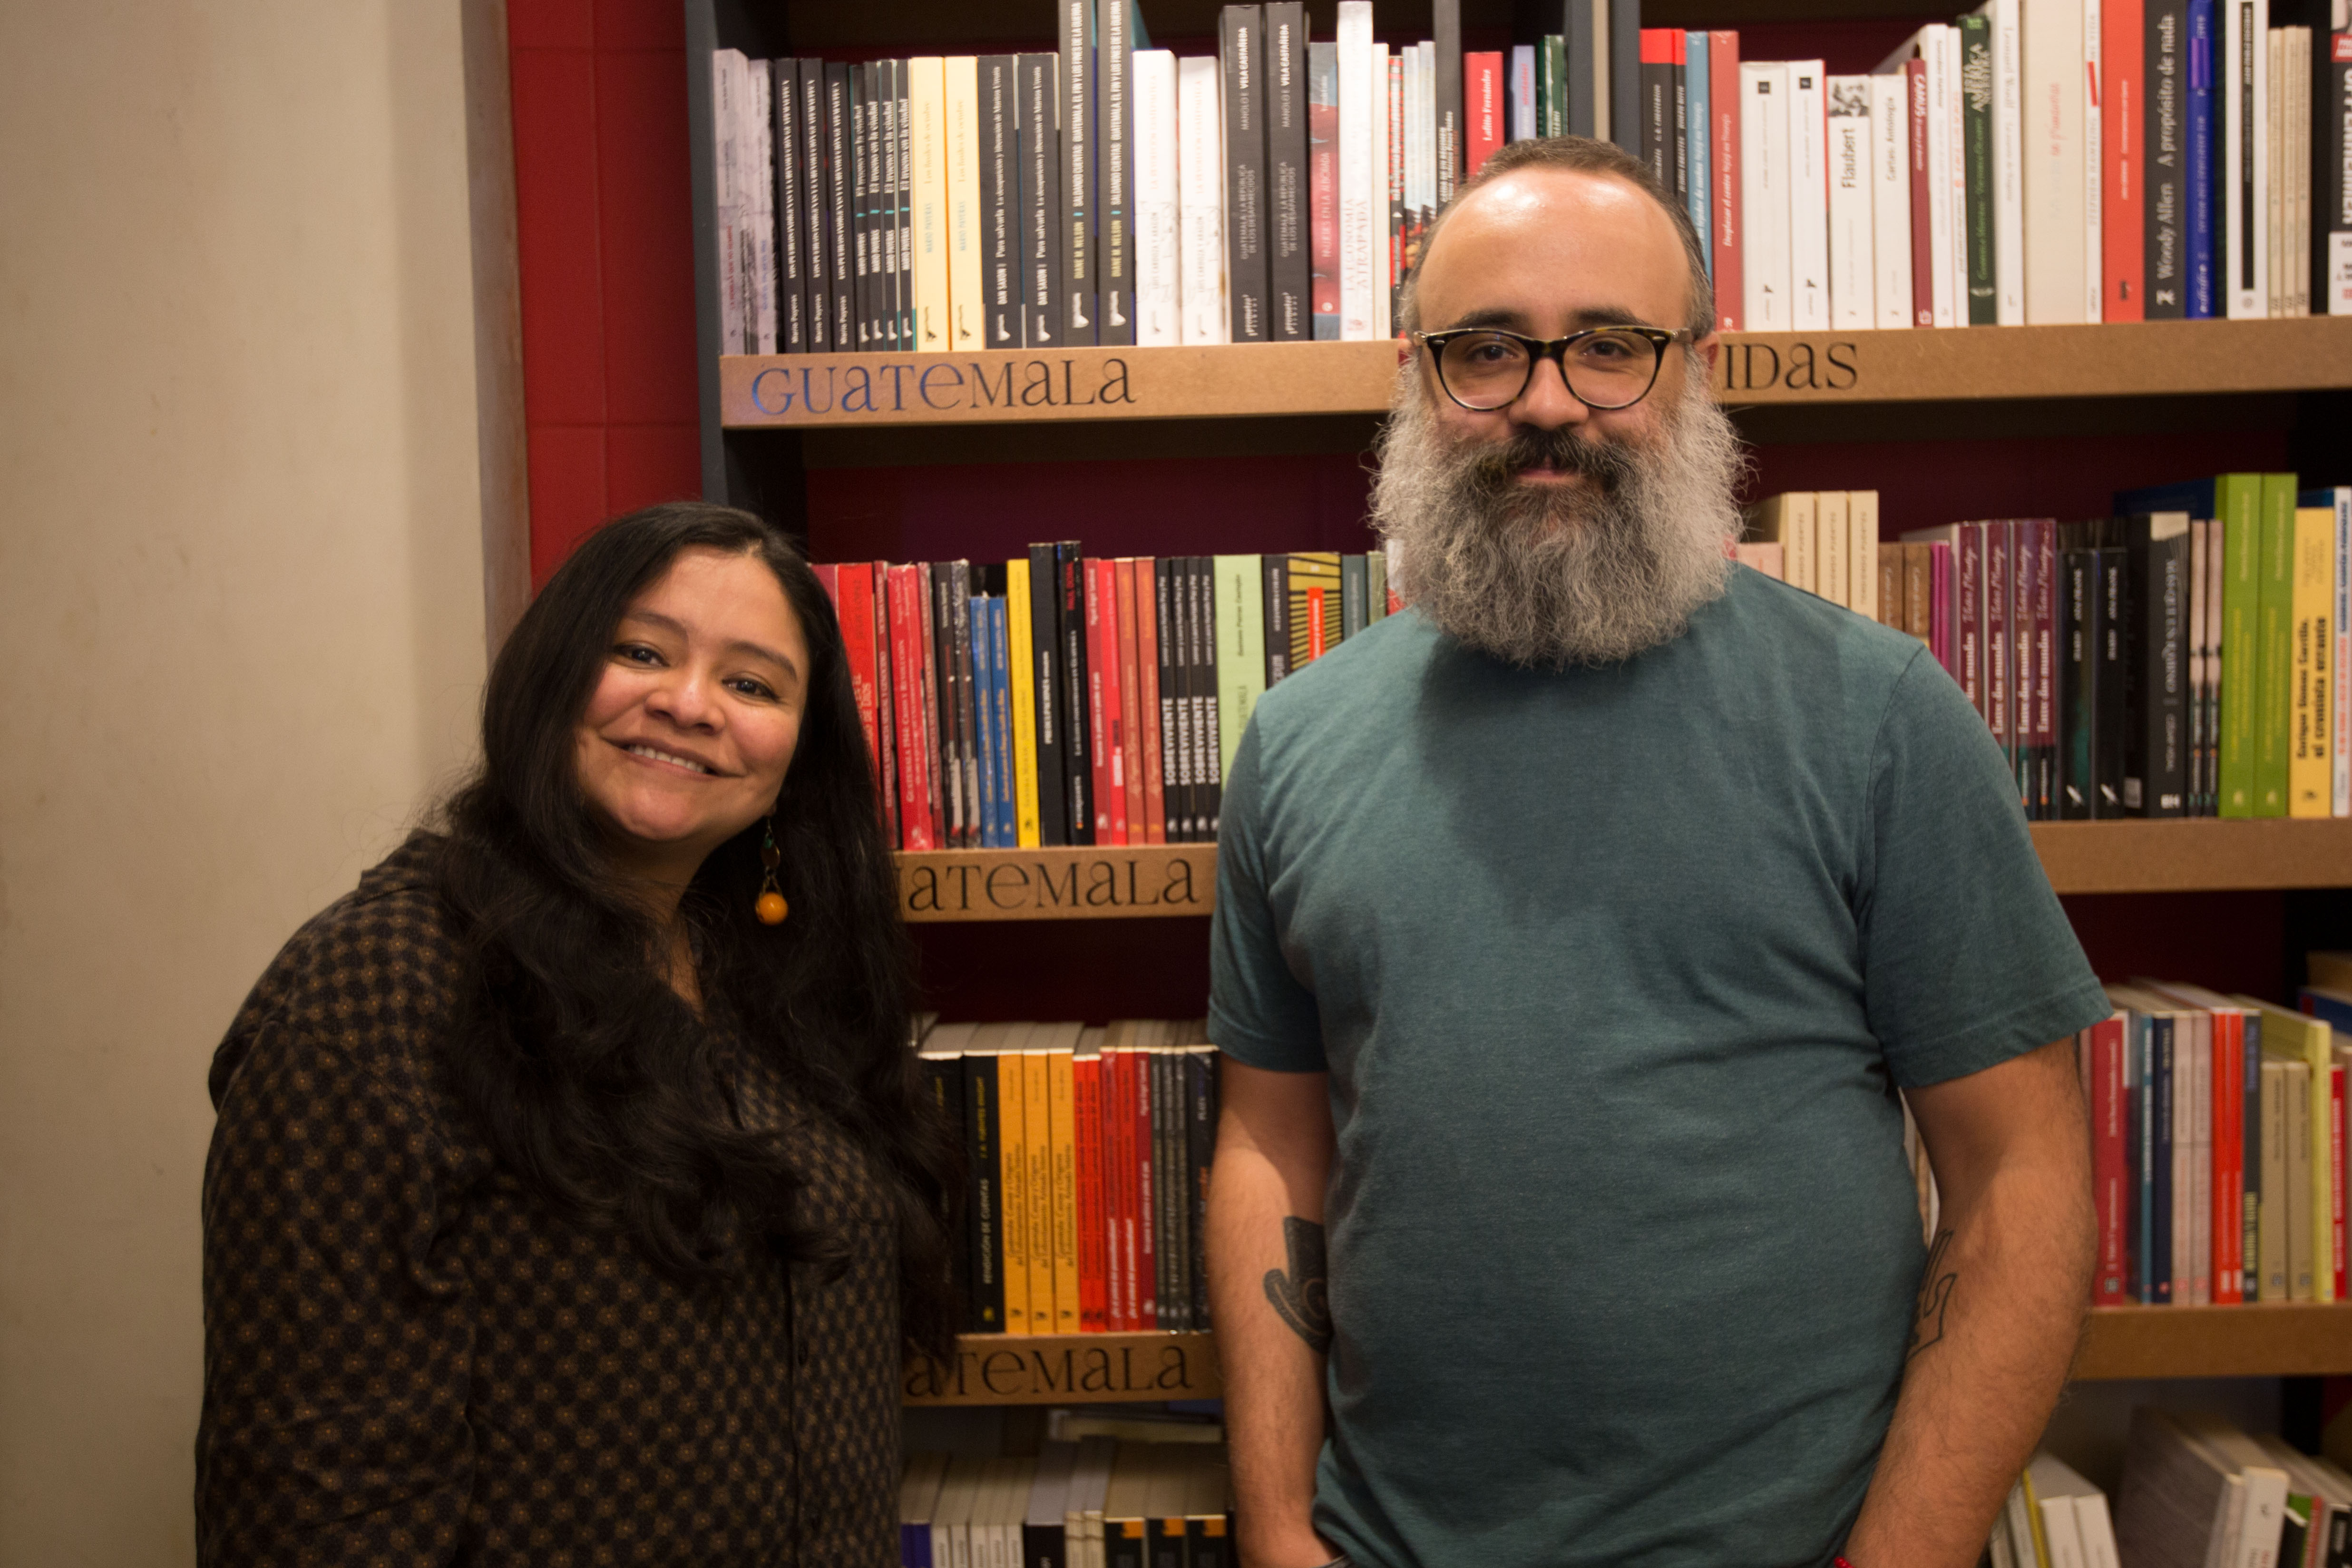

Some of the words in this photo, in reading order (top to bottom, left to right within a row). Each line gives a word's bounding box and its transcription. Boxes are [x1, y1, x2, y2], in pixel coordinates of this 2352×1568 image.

[1237, 28, 1249, 69] CASTAÑEDA
[1278, 25, 1290, 67] CASTAÑEDA
[2157, 58, 2176, 75] de
[1239, 70, 1249, 89] VELA
[1280, 68, 1290, 86] VELA
[2157, 78, 2176, 151] propósito
[1840, 128, 1856, 188] Flaubert
[2157, 183, 2176, 224] Allen
[1074, 222, 1084, 248] NELSON
[1111, 220, 1122, 246] NELSON
[2157, 225, 2176, 279] Woody
[1963, 633, 1975, 678] mundos
[1991, 632, 2003, 678] mundos
[2017, 631, 2029, 678] mundos
[2036, 630, 2049, 677] mundos
[1963, 682, 1975, 701] dos
[1991, 681, 2003, 701] dos
[2018, 680, 2029, 701] dos
[2037, 679, 2049, 699] dos
[1161, 699, 1177, 786] SOBREVIVIENTE
[1176, 698, 1191, 785] SOBREVIVIENTE
[1191, 697, 1206, 784] SOBREVIVIENTE
[1205, 697, 1220, 784] SOBREVIVIENTE
